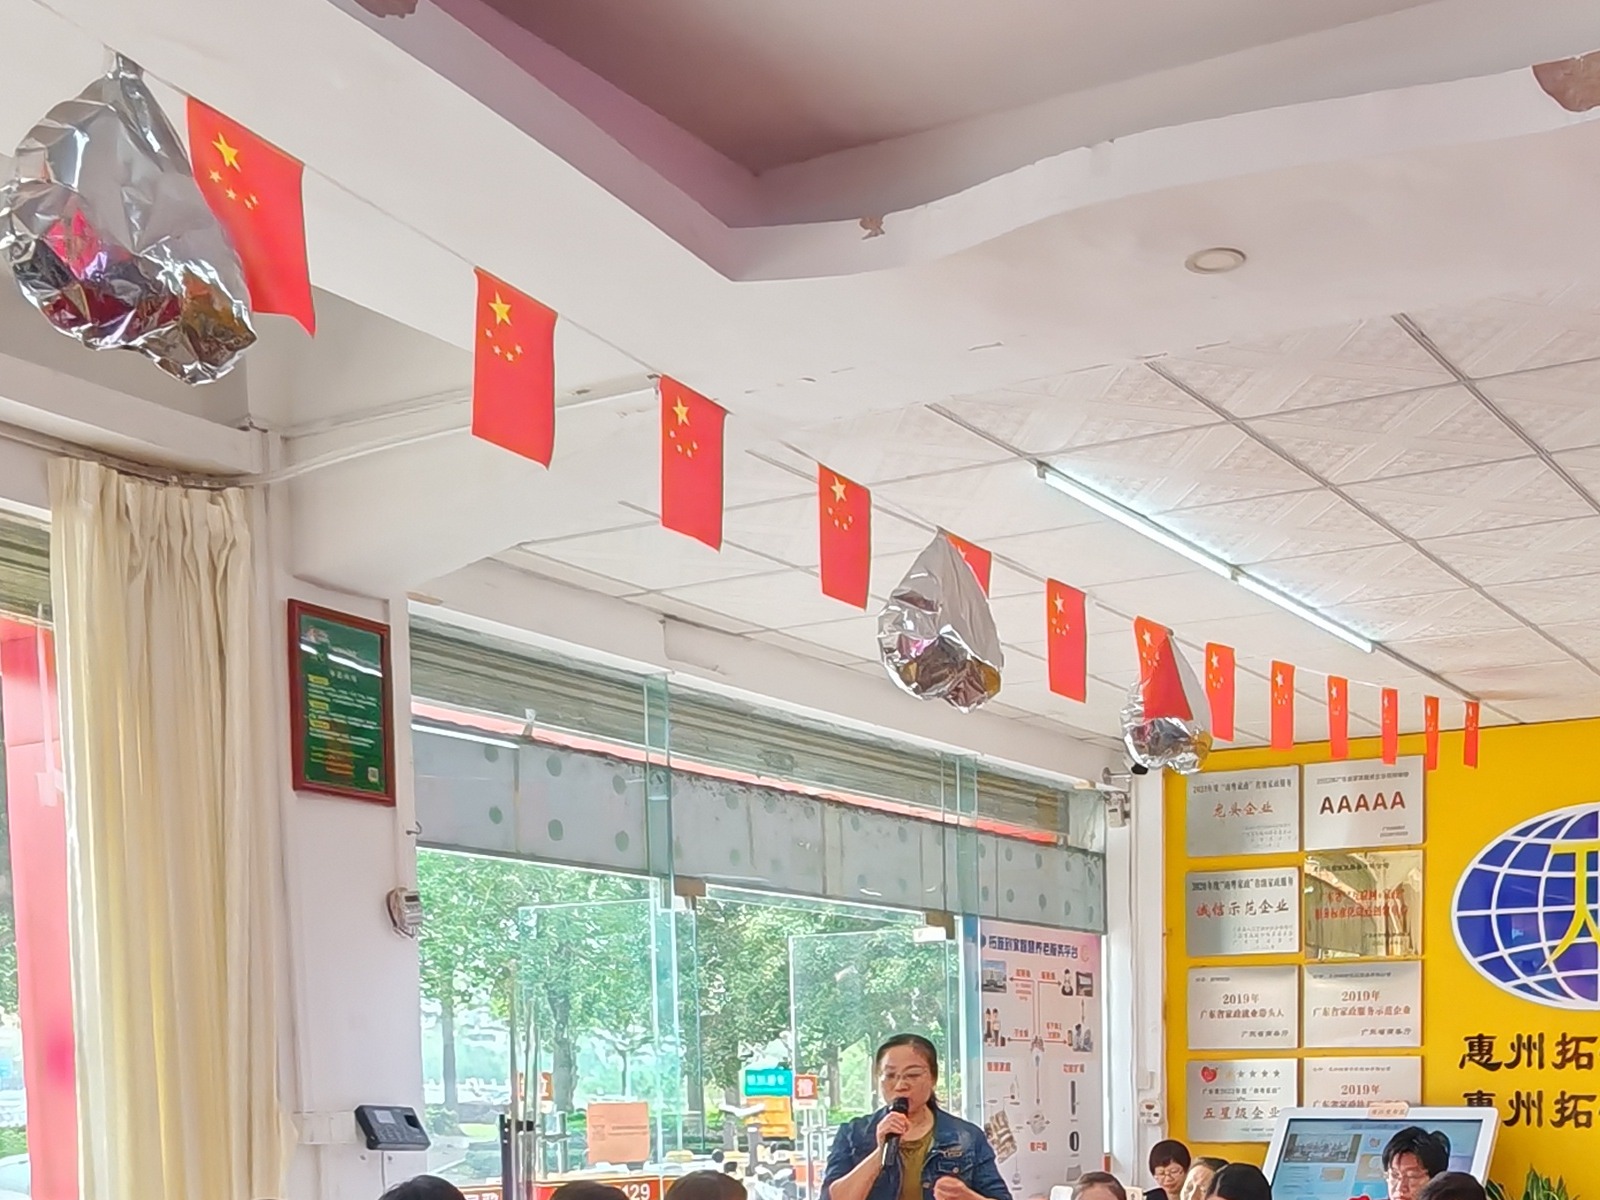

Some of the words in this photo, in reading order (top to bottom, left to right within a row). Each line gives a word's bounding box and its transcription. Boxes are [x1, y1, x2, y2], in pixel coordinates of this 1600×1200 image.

[1213, 801, 1273, 818] 龙头企业
[1320, 791, 1406, 815] AAAAA
[1196, 898, 1289, 918] 诚信示范企业
[1222, 993, 1260, 1005] 2019年
[1341, 990, 1381, 1002] 2019年
[1341, 1084, 1381, 1096] 2019年
[1203, 1105, 1280, 1120] 五星级企业
